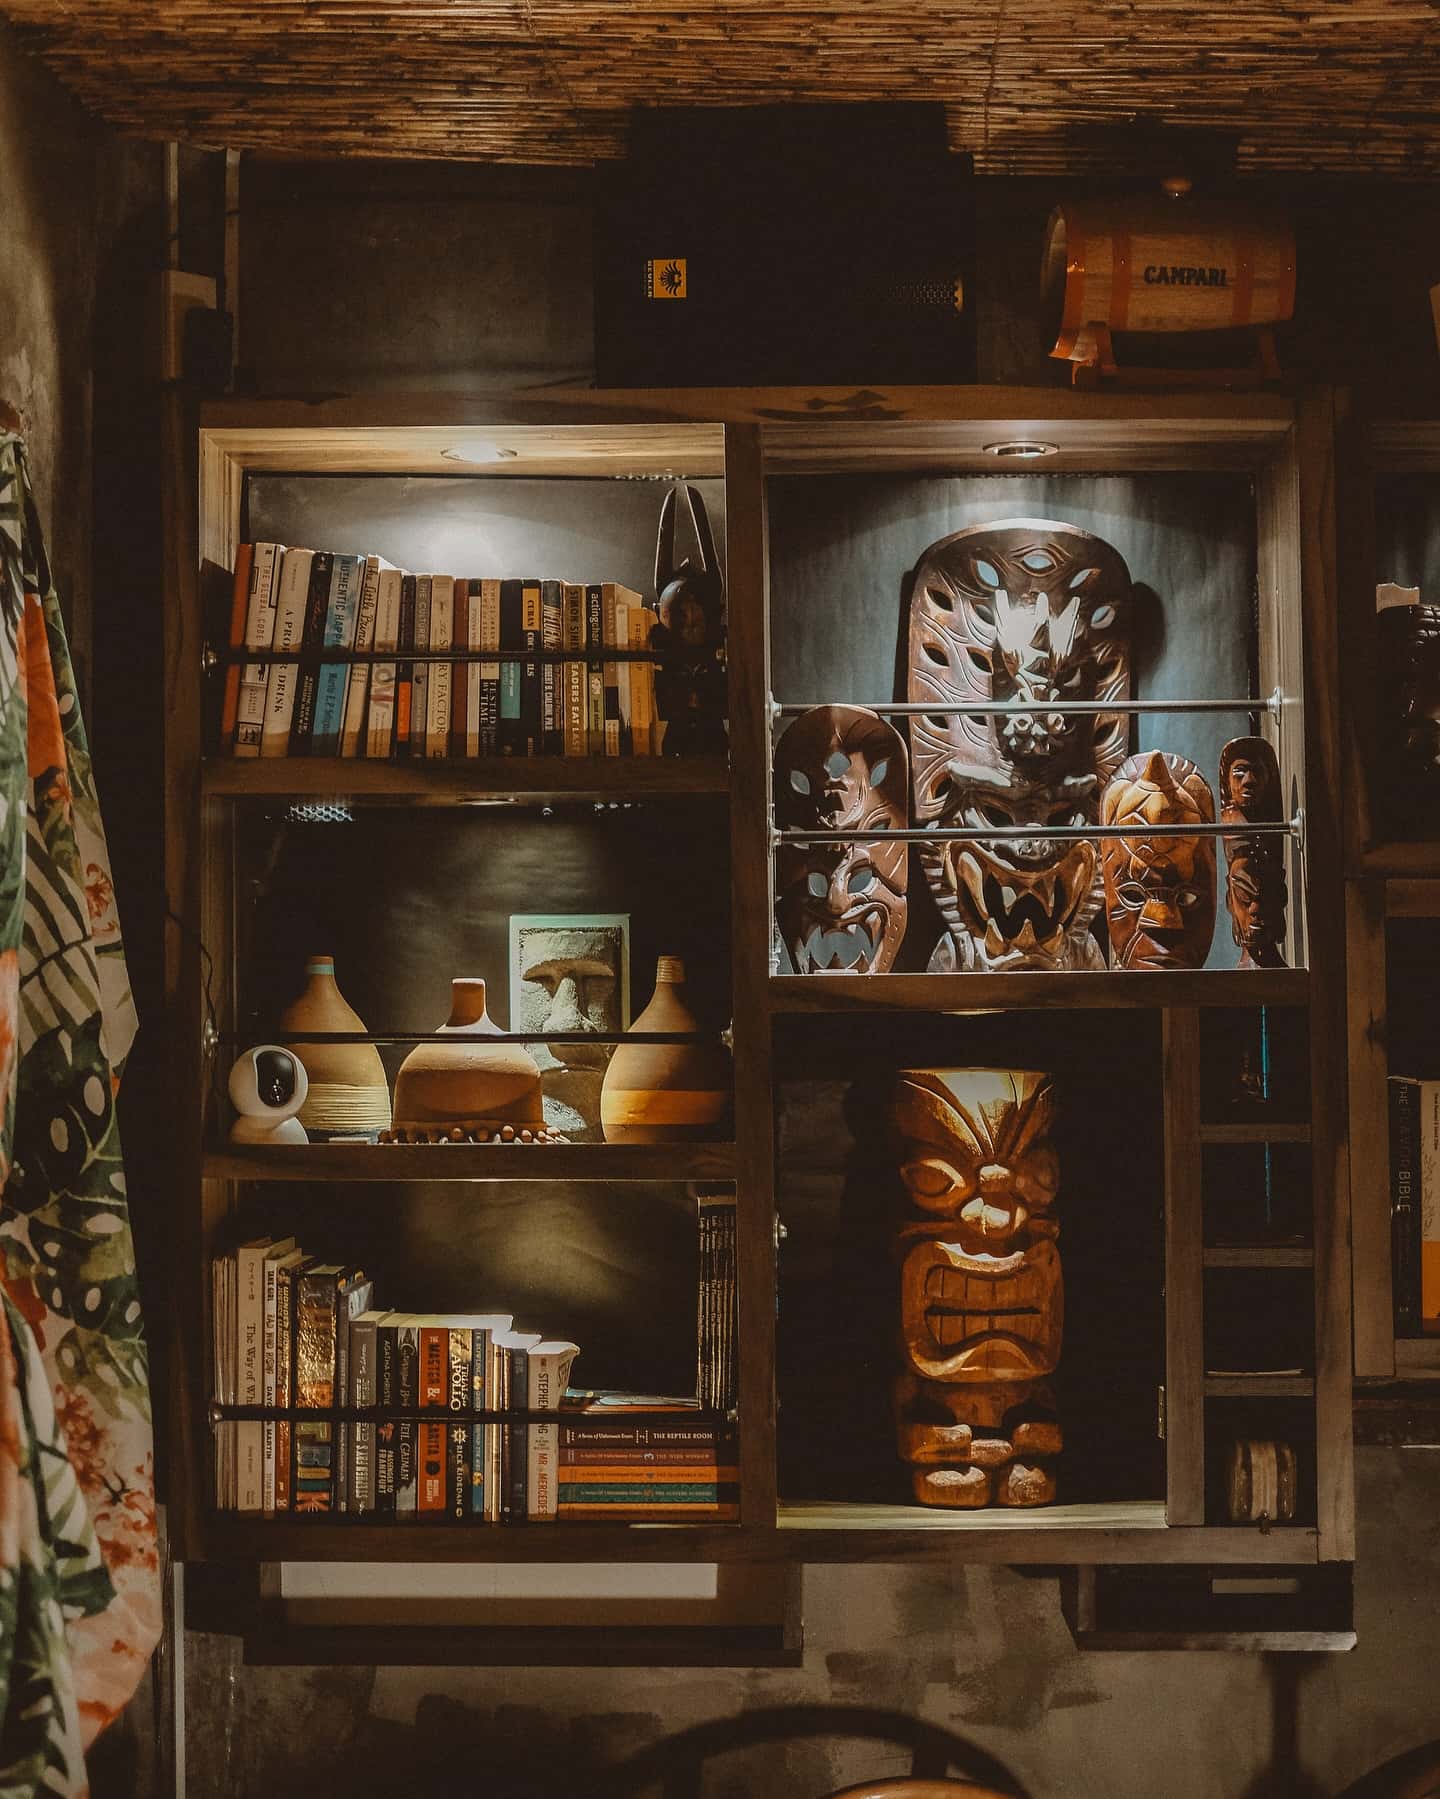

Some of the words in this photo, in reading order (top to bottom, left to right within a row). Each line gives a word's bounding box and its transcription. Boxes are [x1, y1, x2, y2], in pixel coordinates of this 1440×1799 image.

[1143, 266, 1227, 287] CAMPARI
[335, 560, 350, 611] AUTHENTIC
[366, 565, 378, 581] The
[361, 583, 377, 610] Little
[357, 613, 374, 649] Prince
[275, 672, 287, 712] DRINK
[571, 664, 579, 703] EADERS
[436, 684, 448, 735] FACTOR
[480, 695, 488, 724] TIME
[571, 706, 579, 725] EAT
[571, 727, 579, 752] LAST
[1398, 1171, 1411, 1215] BIBLE
[246, 1323, 256, 1344] The
[245, 1347, 256, 1367] Way
[383, 1340, 391, 1371] AGATHA
[246, 1370, 256, 1381] of
[450, 1353, 461, 1411] APOLLO
[461, 1364, 469, 1399] TRIALS
[538, 1373, 549, 1410] STEPHEN
[378, 1449, 387, 1494] FRANKFURT
[456, 1445, 464, 1465] RICK
[537, 1473, 548, 1515] MERCEDES
